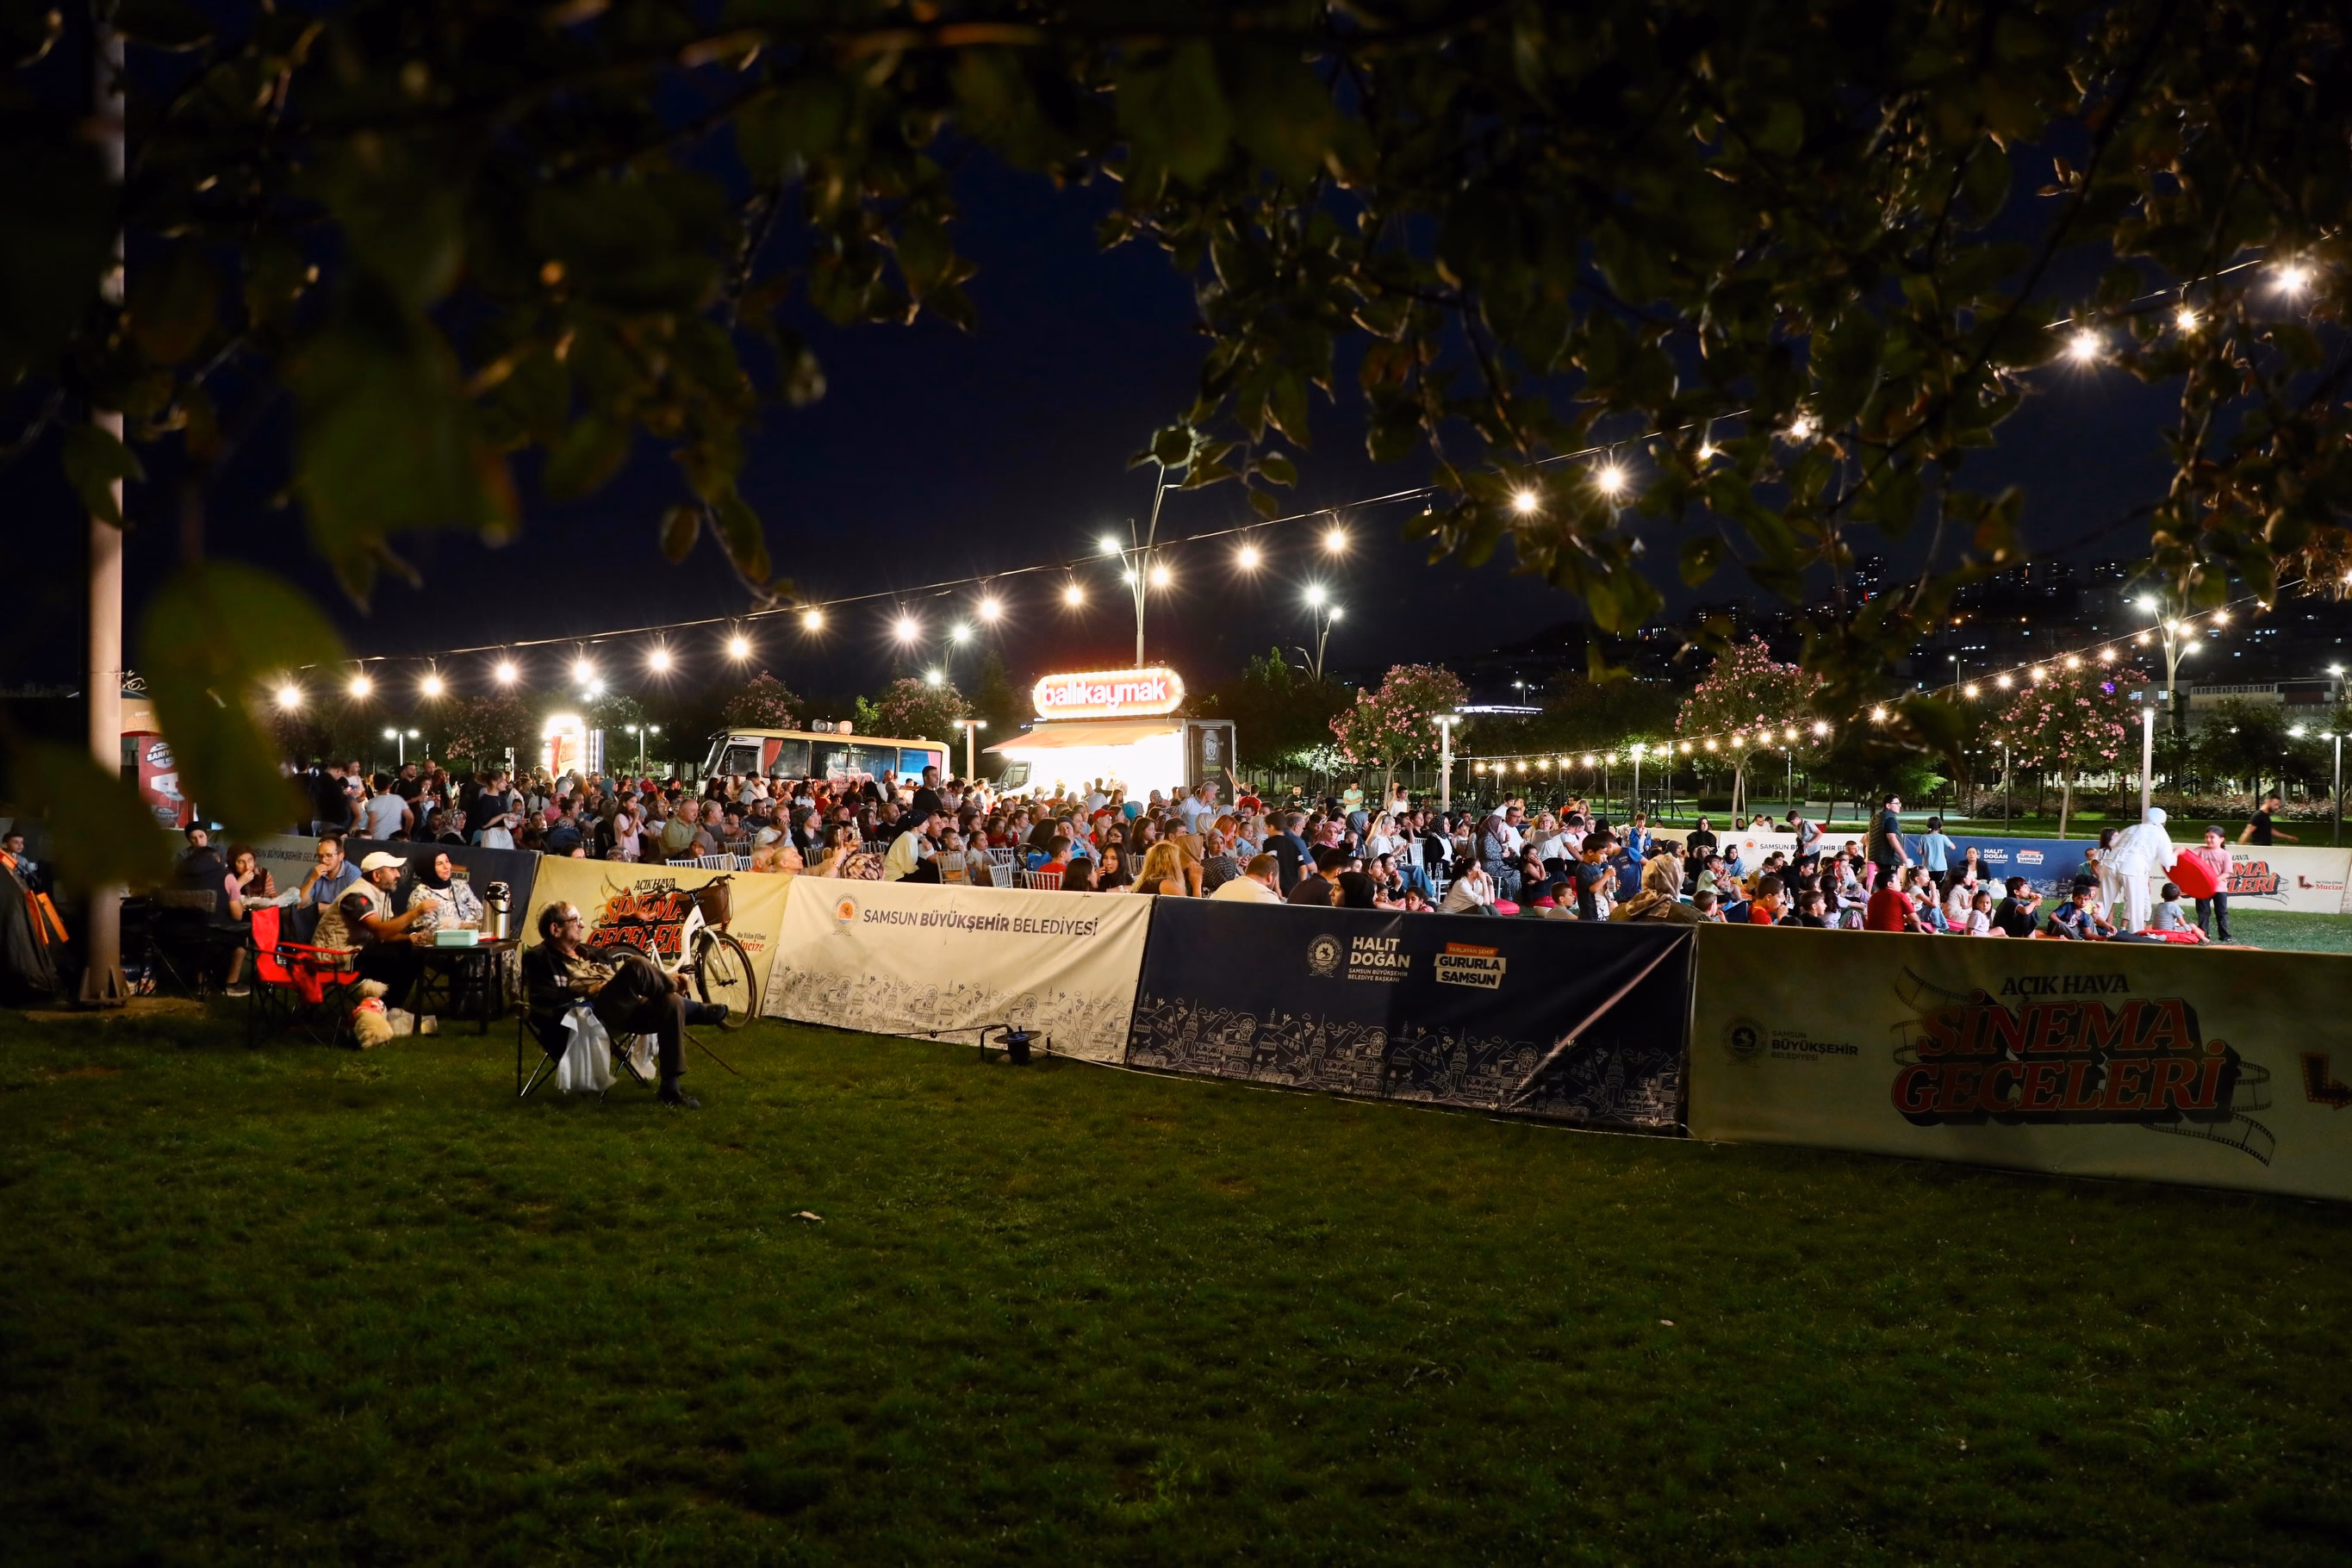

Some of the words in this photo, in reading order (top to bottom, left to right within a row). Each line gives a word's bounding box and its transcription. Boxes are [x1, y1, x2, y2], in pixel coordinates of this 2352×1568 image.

[634, 879, 653, 894] AÇIK
[653, 877, 676, 891] HAVA
[863, 909, 918, 926] SAMSUN
[919, 910, 1010, 933] BÜYÜKŞEHİR
[1012, 917, 1098, 936] BELEDİYESİ
[1352, 936, 1400, 951] HALİT
[1349, 951, 1410, 968] DOĞAN
[1439, 955, 1501, 971] GURURLA
[1372, 968, 1408, 977] BÜYÜKŞEHİR
[1440, 971, 1496, 986] SAMSUN
[2000, 975, 2060, 1002] AÇIK
[2062, 974, 2131, 993] HAVA
[1916, 988, 2196, 1058] SİNEMA
[1772, 1030, 1807, 1039] SAMSUN
[1771, 1038, 1858, 1056] BÜYÜKŞEHİR
[1770, 1051, 1818, 1061] BELEDİYESİ
[1891, 1039, 2228, 1115] GECELERİ
